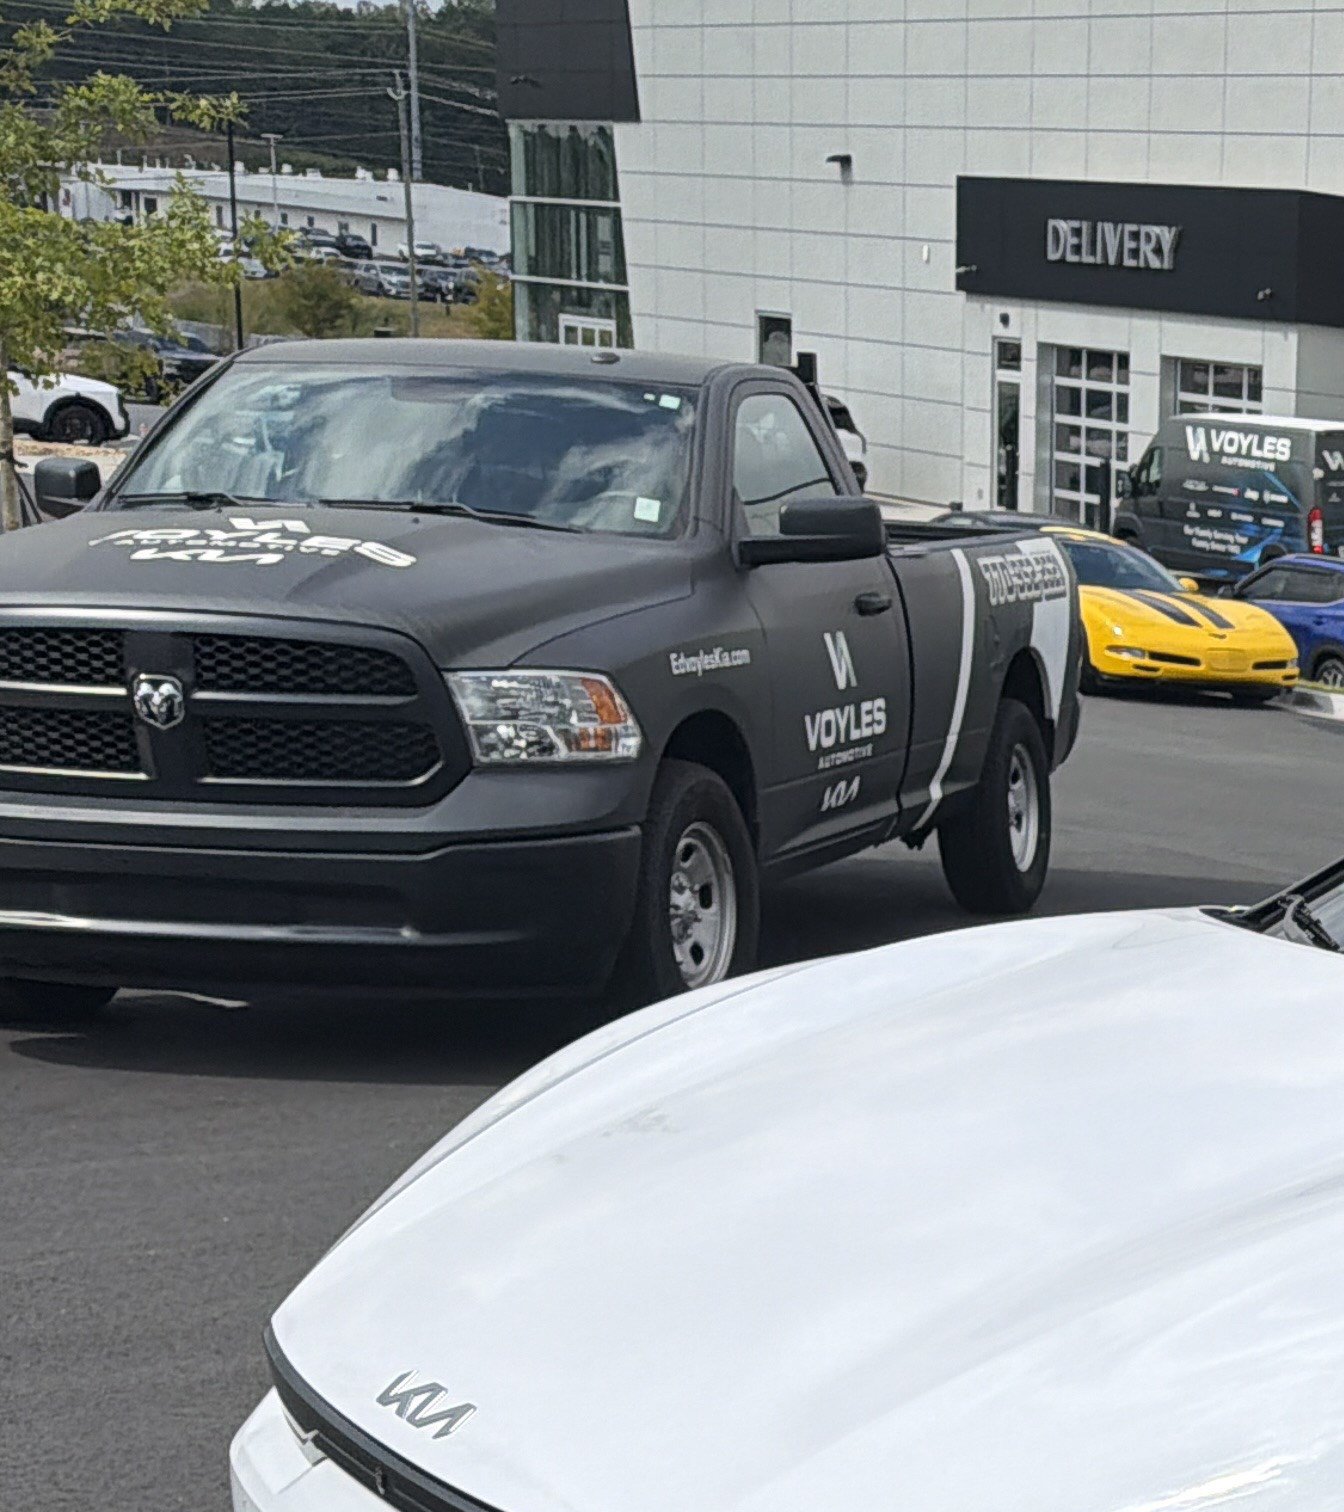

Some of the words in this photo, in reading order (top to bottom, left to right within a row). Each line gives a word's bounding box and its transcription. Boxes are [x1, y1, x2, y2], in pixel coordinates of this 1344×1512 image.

[1047, 218, 1180, 270] DELIVERY
[1211, 428, 1292, 462] VOYLES
[804, 697, 887, 751] VOYLES
[375, 1369, 478, 1440] KIA
